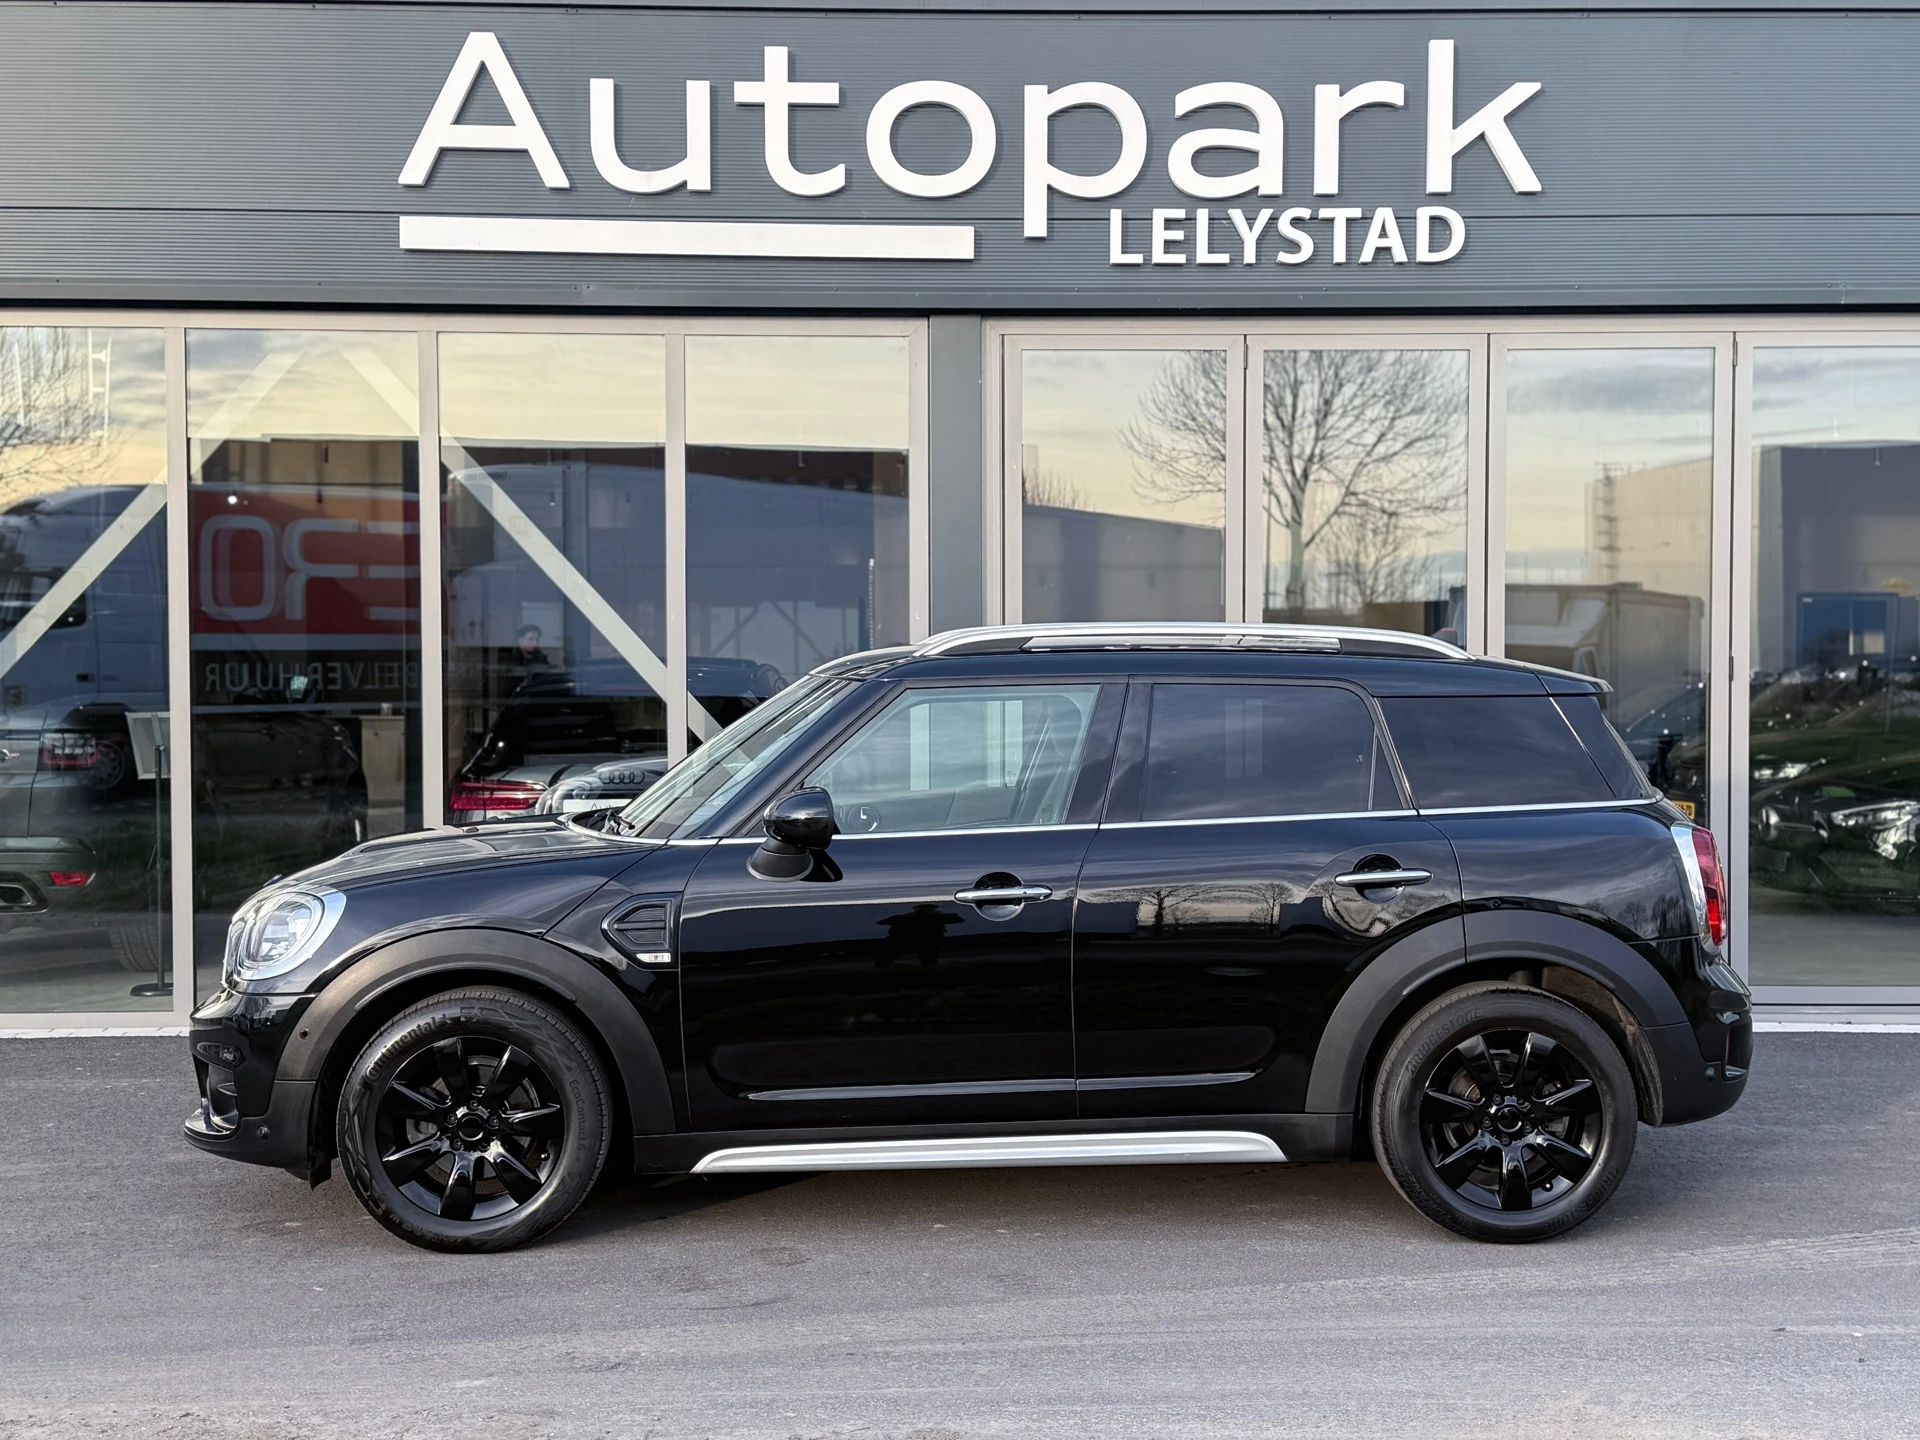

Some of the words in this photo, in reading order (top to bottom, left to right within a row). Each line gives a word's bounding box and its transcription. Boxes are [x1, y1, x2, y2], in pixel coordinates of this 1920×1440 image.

[397, 32, 1543, 239] Autopark
[1109, 206, 1466, 266] LELYSTAD
[569, 1080, 588, 1141] EcoContact
